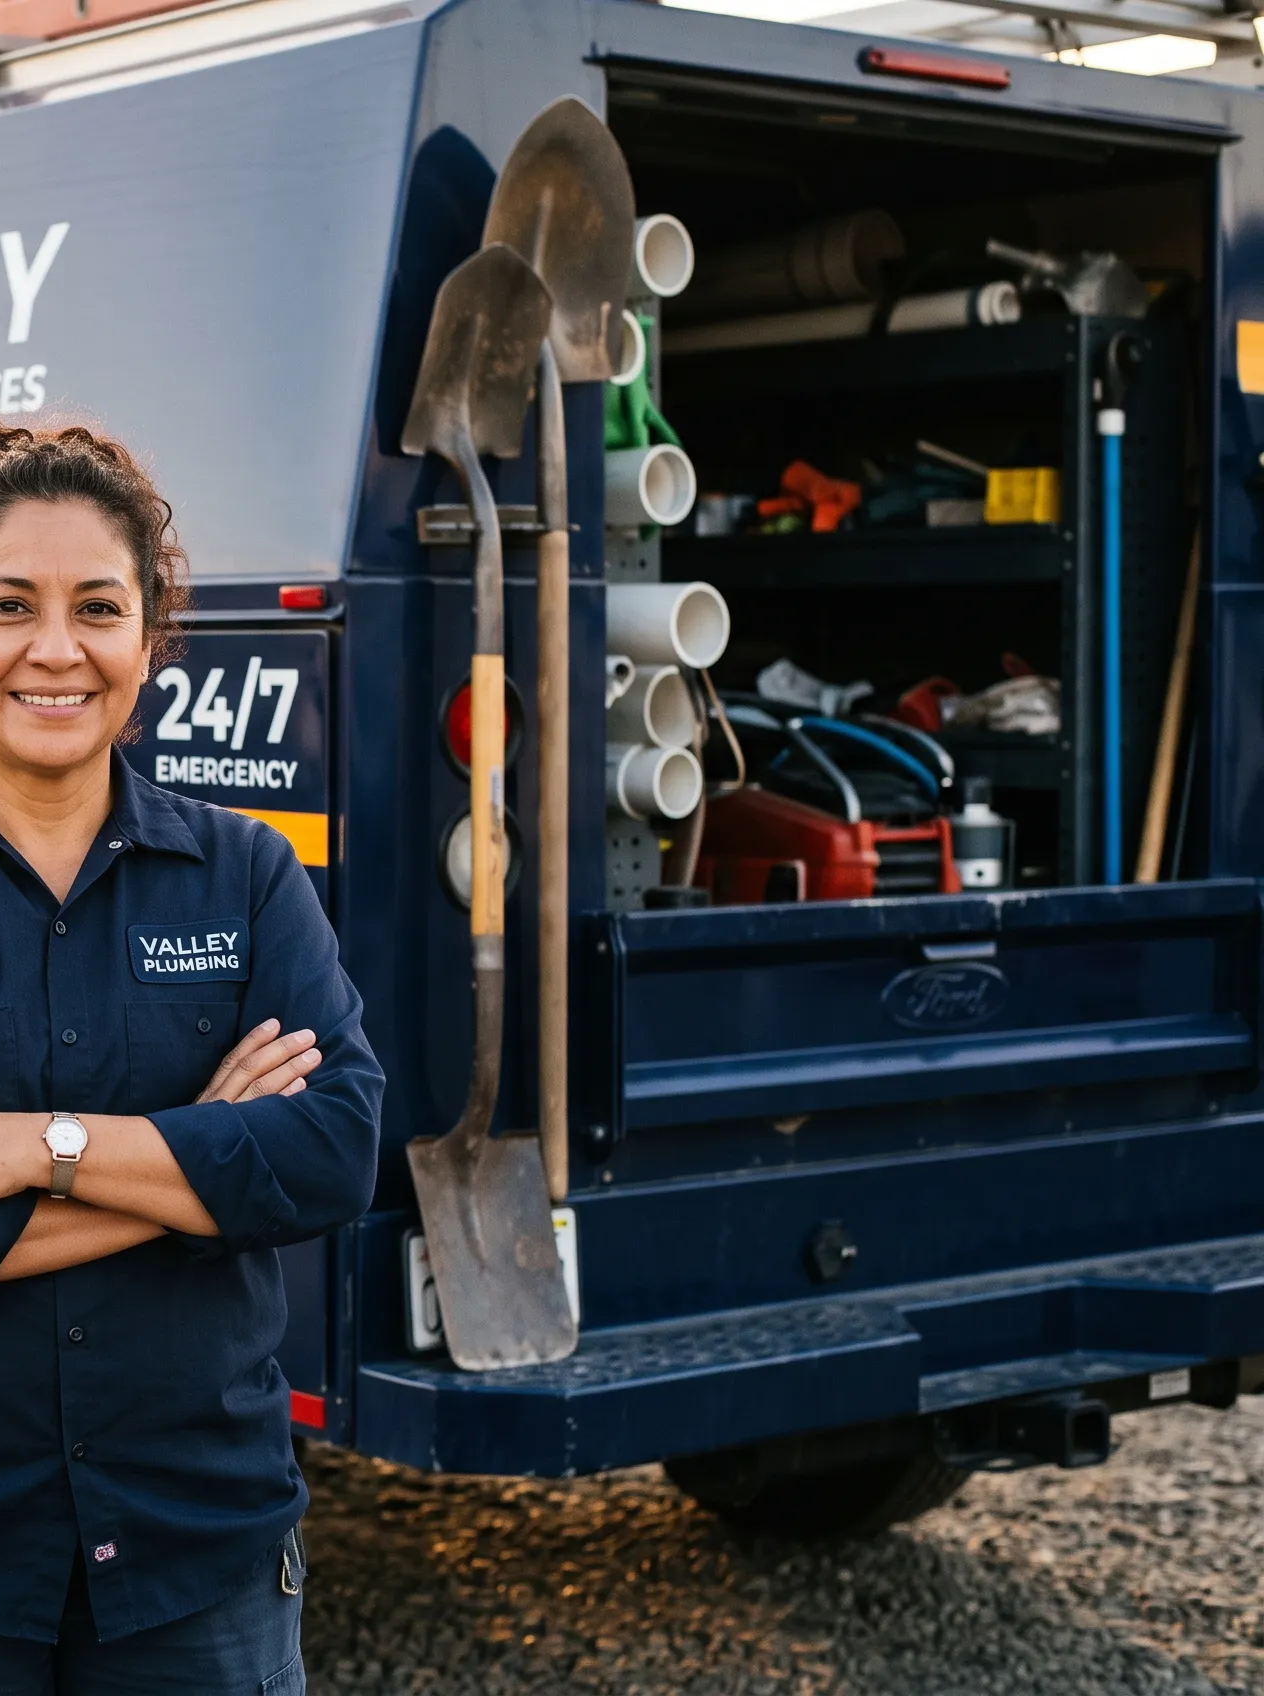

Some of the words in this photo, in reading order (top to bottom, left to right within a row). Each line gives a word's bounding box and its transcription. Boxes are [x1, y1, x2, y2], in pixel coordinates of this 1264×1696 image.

[156, 656, 300, 751] 24/7
[155, 755, 299, 790] EMERGENCY
[139, 931, 239, 956] VALLEY
[143, 954, 239, 973] PLUMBING
